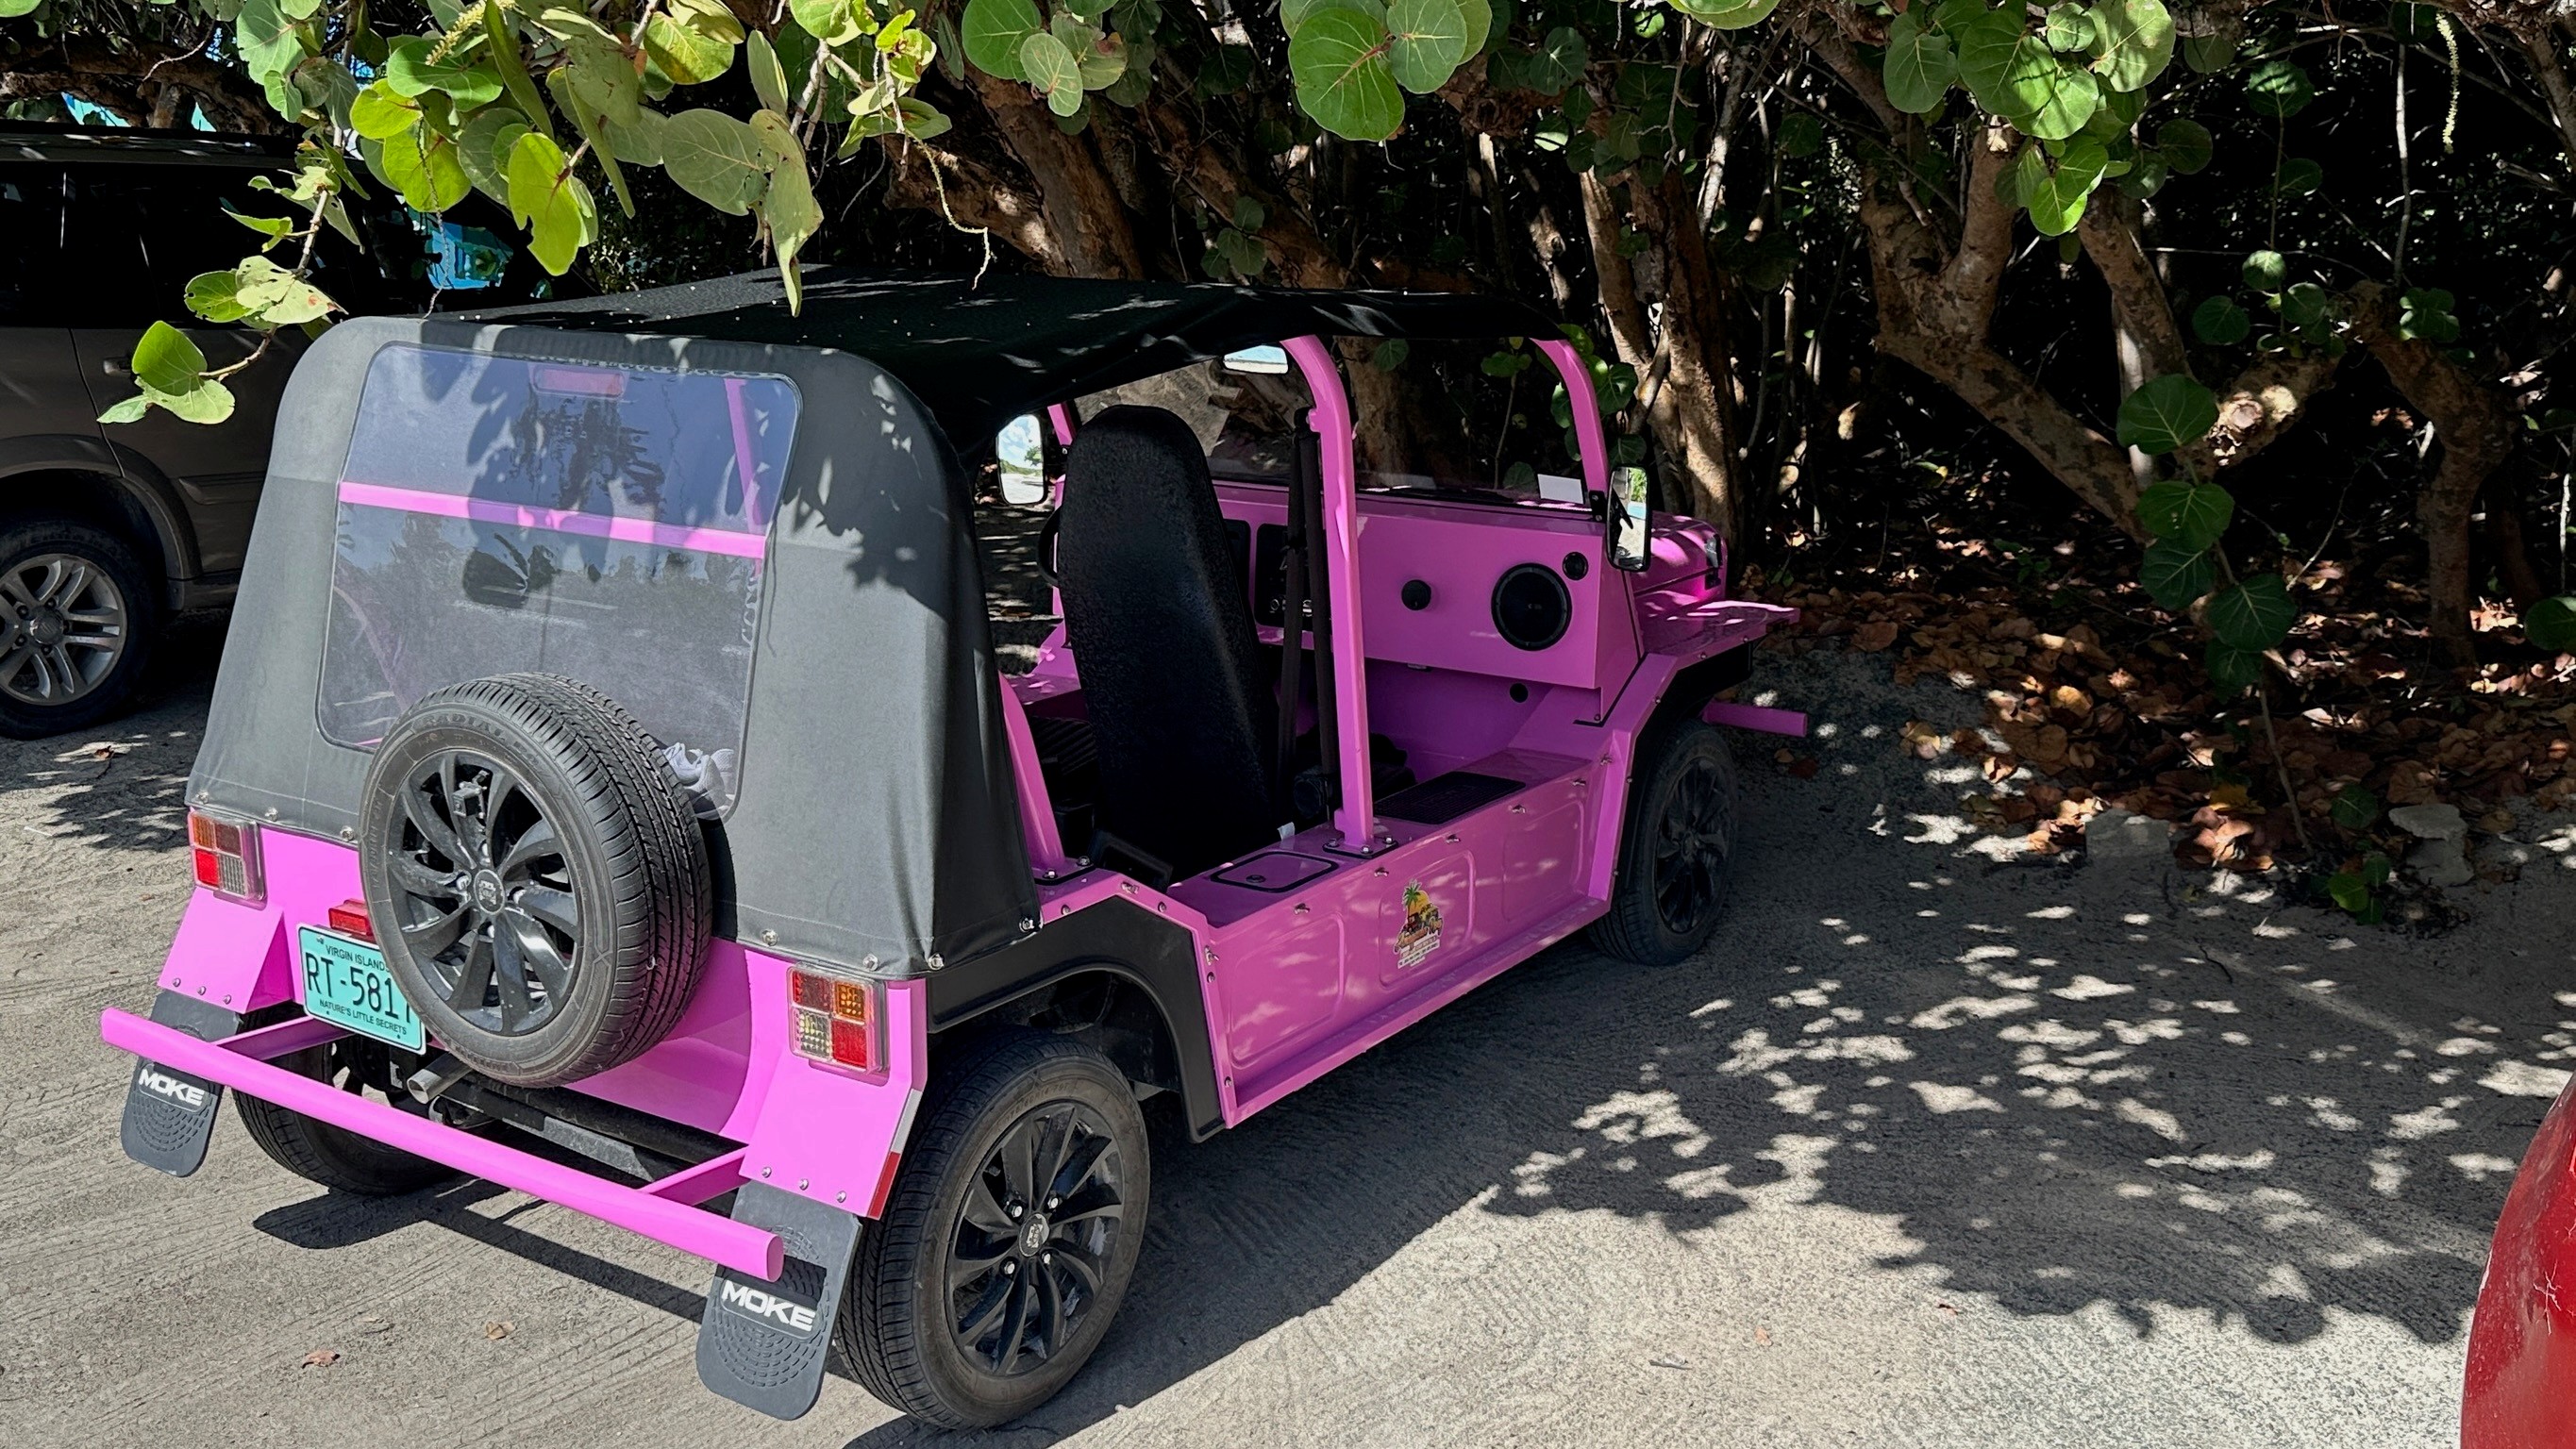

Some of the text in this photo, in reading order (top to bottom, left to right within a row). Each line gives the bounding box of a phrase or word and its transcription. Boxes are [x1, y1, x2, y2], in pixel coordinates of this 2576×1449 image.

[326, 945, 353, 961] VIRGIN
[320, 998, 407, 1035] NATURE'S LITTLE SECRETS
[138, 1068, 205, 1107] MOKE
[721, 1279, 816, 1332] MOKE
